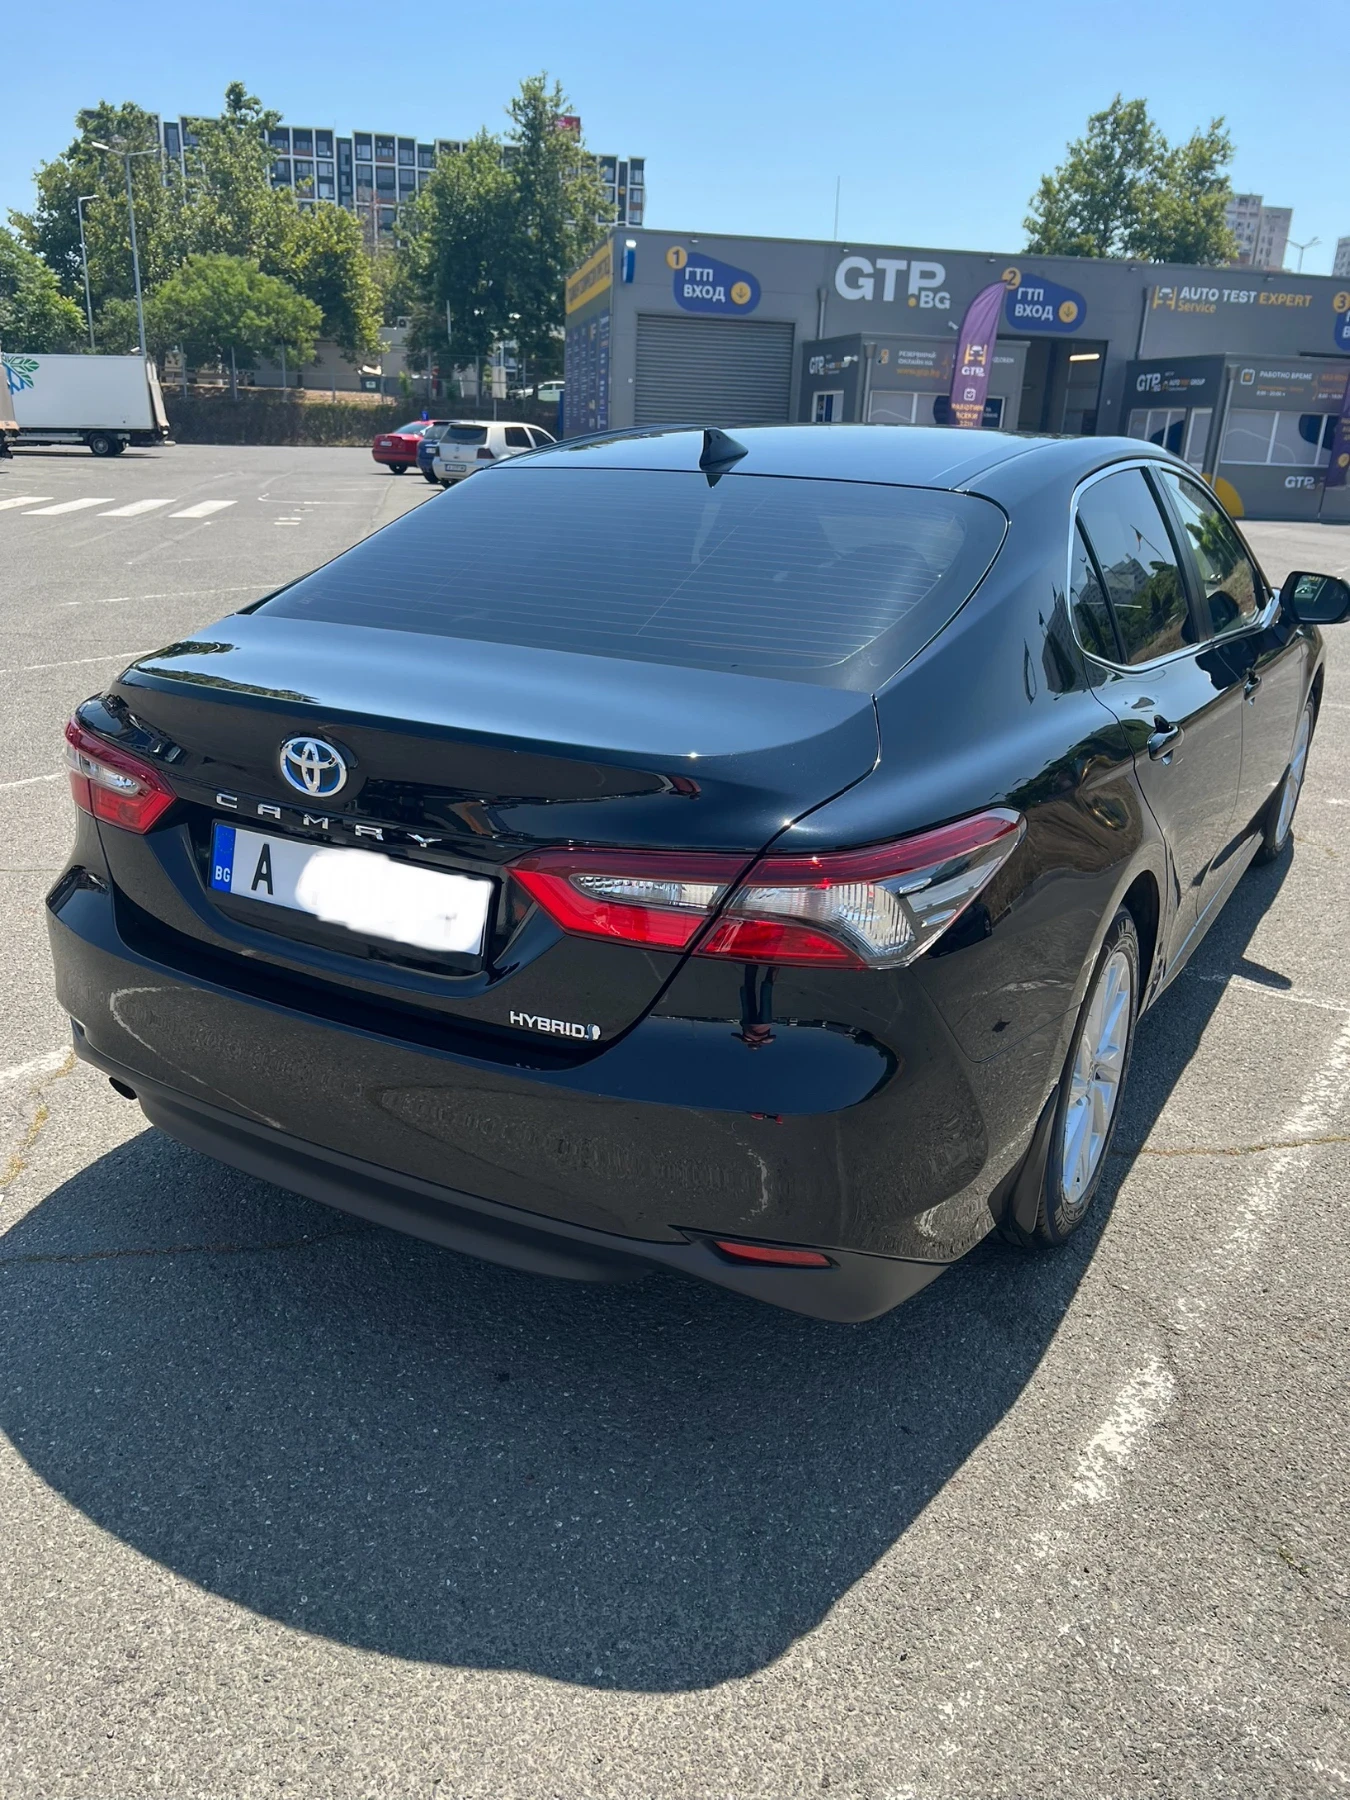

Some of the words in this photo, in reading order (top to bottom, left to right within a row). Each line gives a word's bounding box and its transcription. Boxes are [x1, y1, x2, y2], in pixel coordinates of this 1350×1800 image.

[674, 250, 681, 266] 1
[685, 267, 714, 282] ГТП
[1008, 270, 1018, 287] 2
[683, 283, 726, 303] ВХОД
[1017, 286, 1045, 302] ГТП
[1180, 285, 1219, 302] AUTO
[1222, 289, 1257, 304] TEST
[1260, 292, 1313, 308] EXPERT
[1015, 303, 1054, 321] ВХОД
[1177, 298, 1217, 314] Service
[215, 792, 442, 848] CAMRY
[215, 867, 231, 883] BG
[509, 1010, 585, 1039] HYBRID
